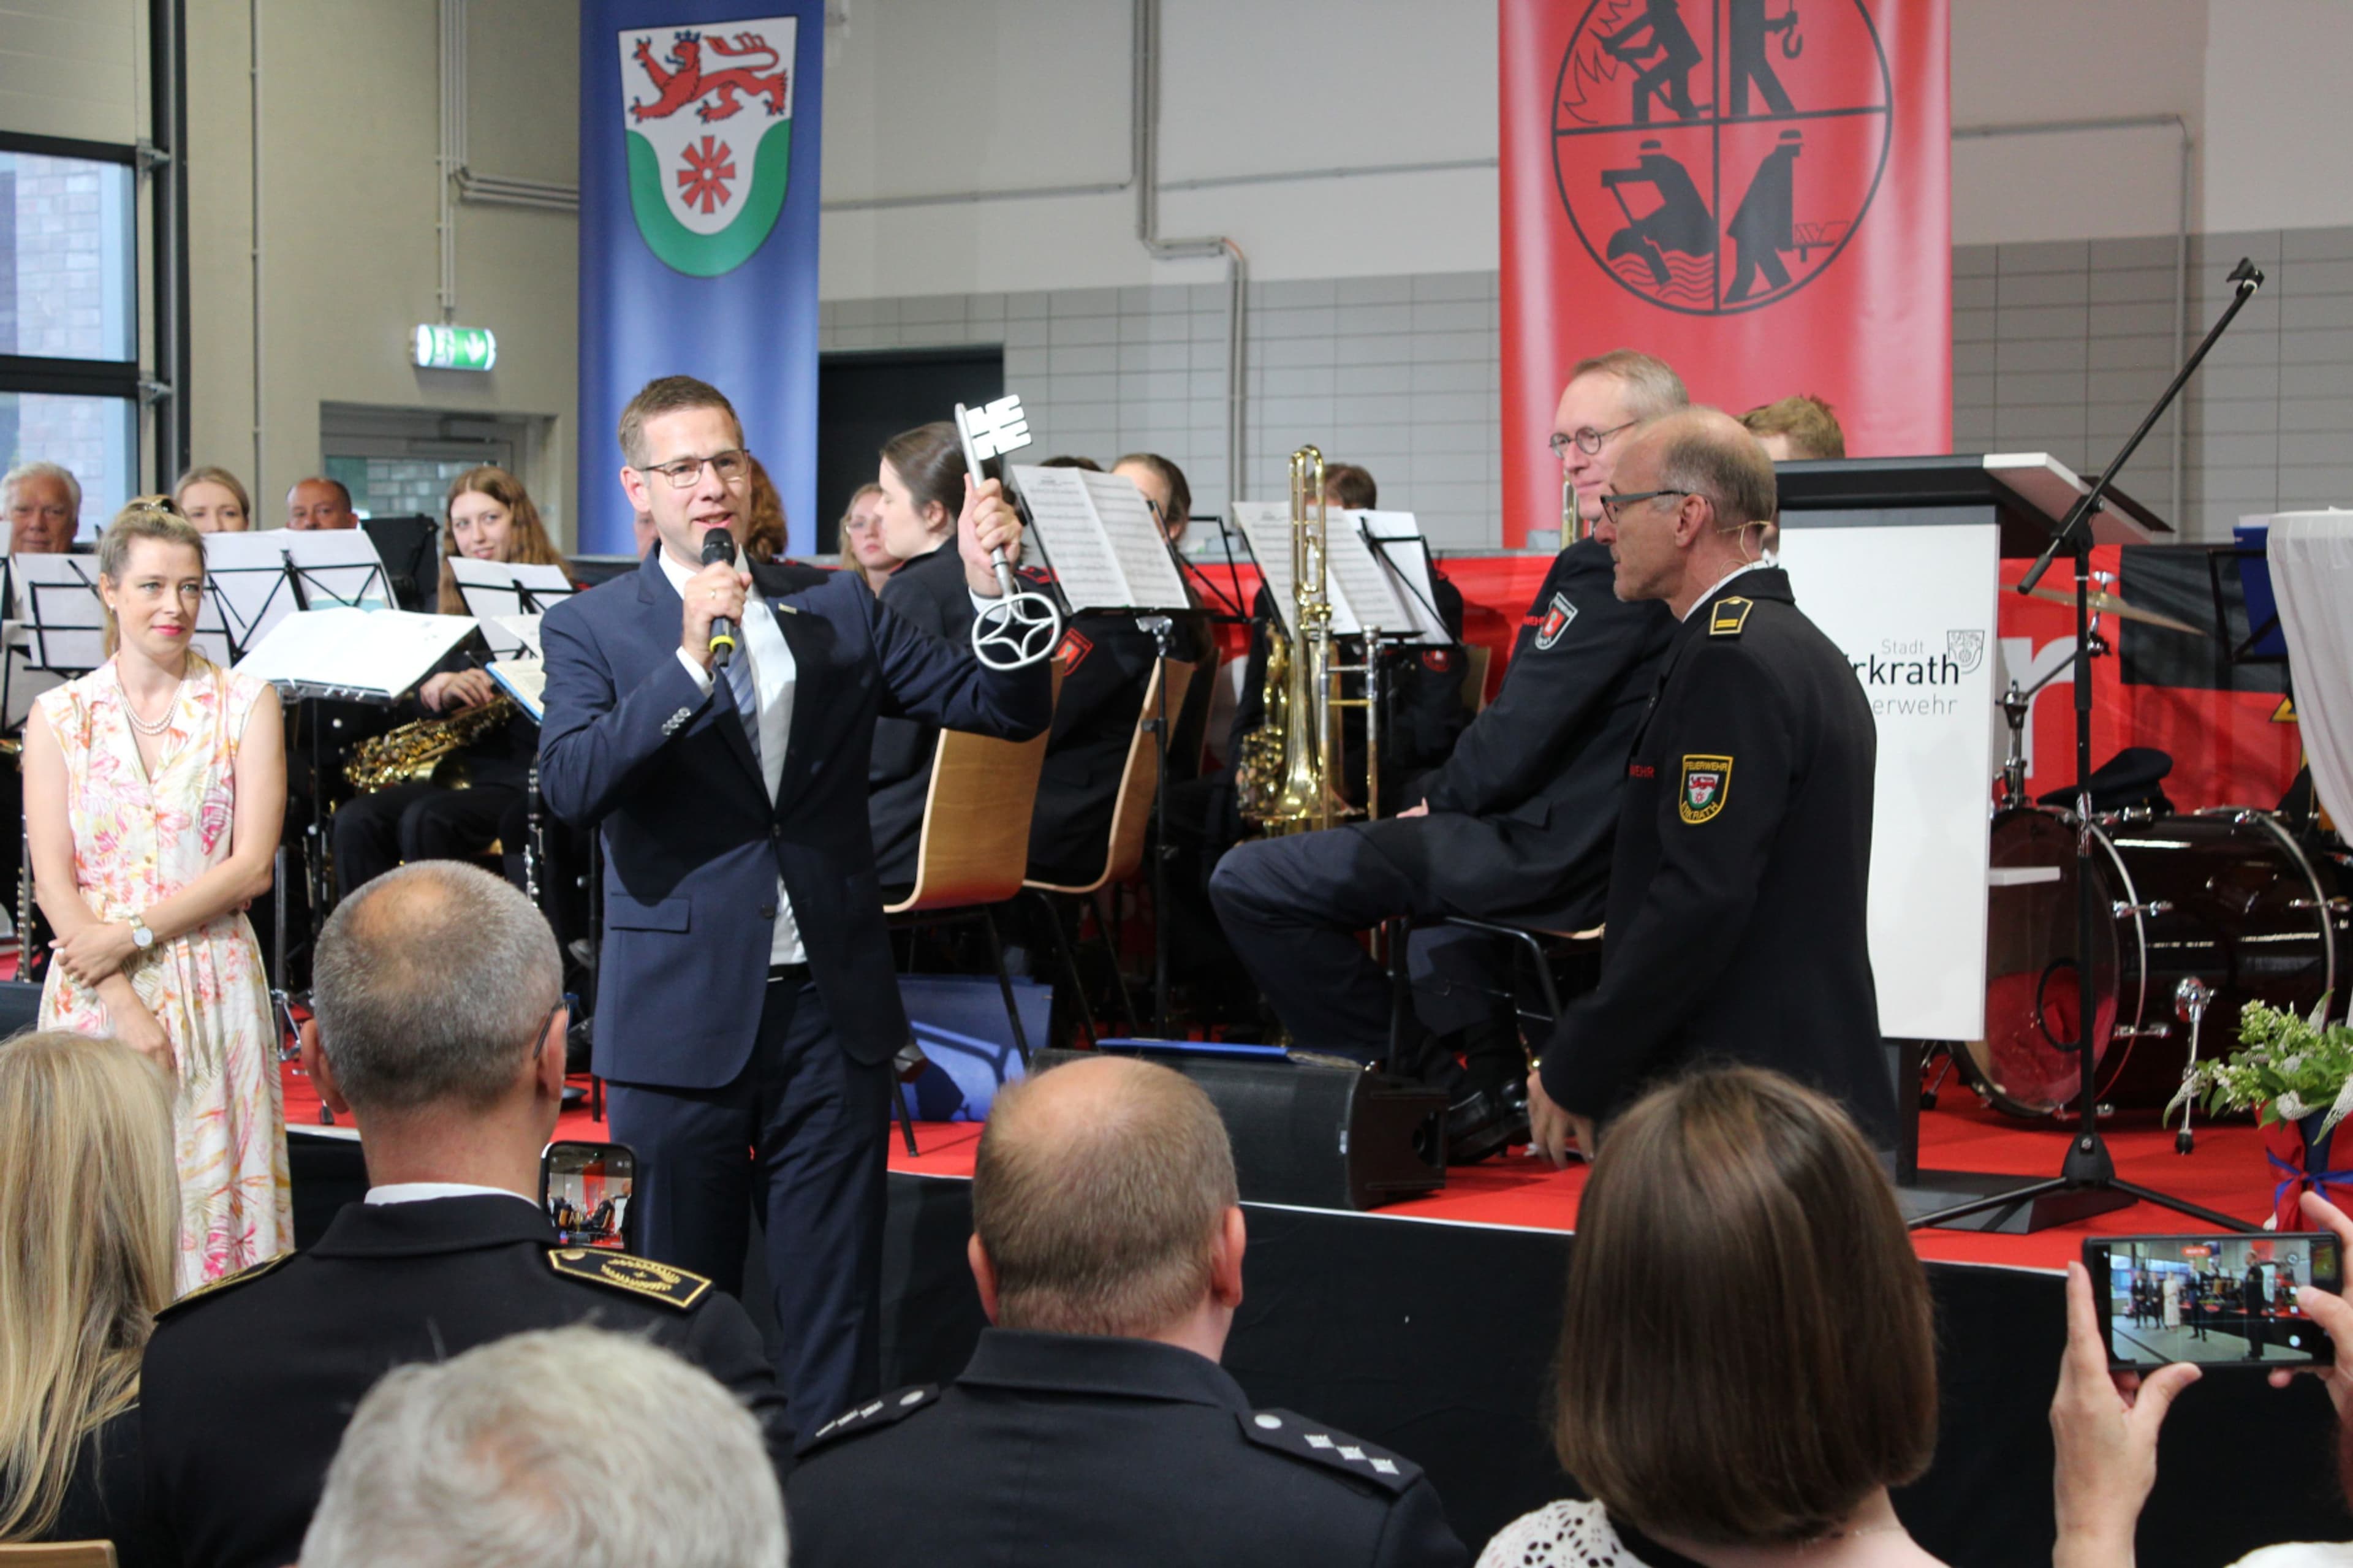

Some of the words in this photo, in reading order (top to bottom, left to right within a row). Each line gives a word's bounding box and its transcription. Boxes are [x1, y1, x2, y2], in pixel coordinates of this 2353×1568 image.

[1881, 639, 1924, 654] Stadt
[1846, 654, 1960, 685] rkrath
[1685, 760, 1728, 771] FEUERWEHR
[1681, 800, 1720, 820] ERKRATH
